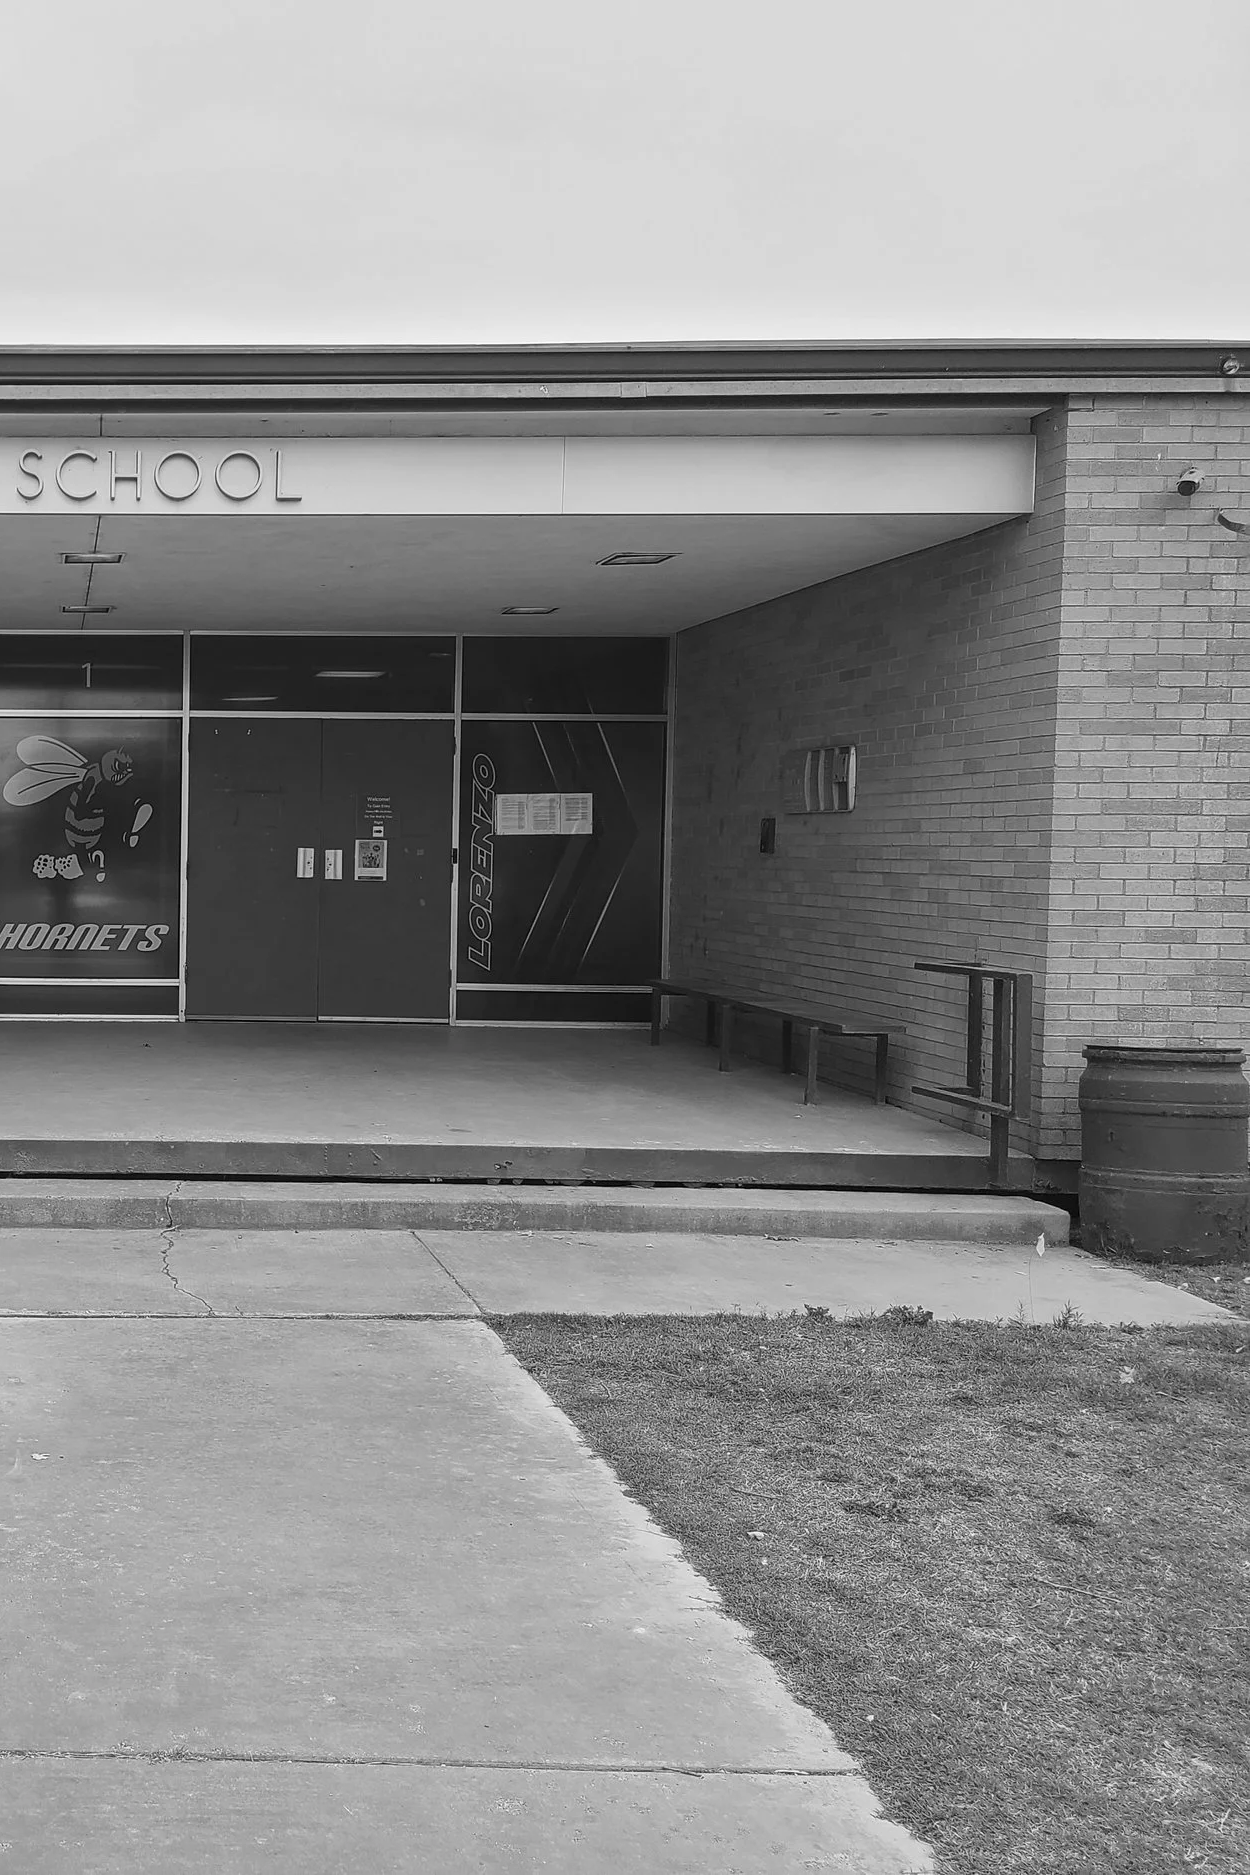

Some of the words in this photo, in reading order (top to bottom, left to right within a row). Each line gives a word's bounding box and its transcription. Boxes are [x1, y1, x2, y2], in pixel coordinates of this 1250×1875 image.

[16, 449, 303, 501] SCHOOL
[81, 662, 92, 688] 1
[468, 753, 496, 971] LORENZO
